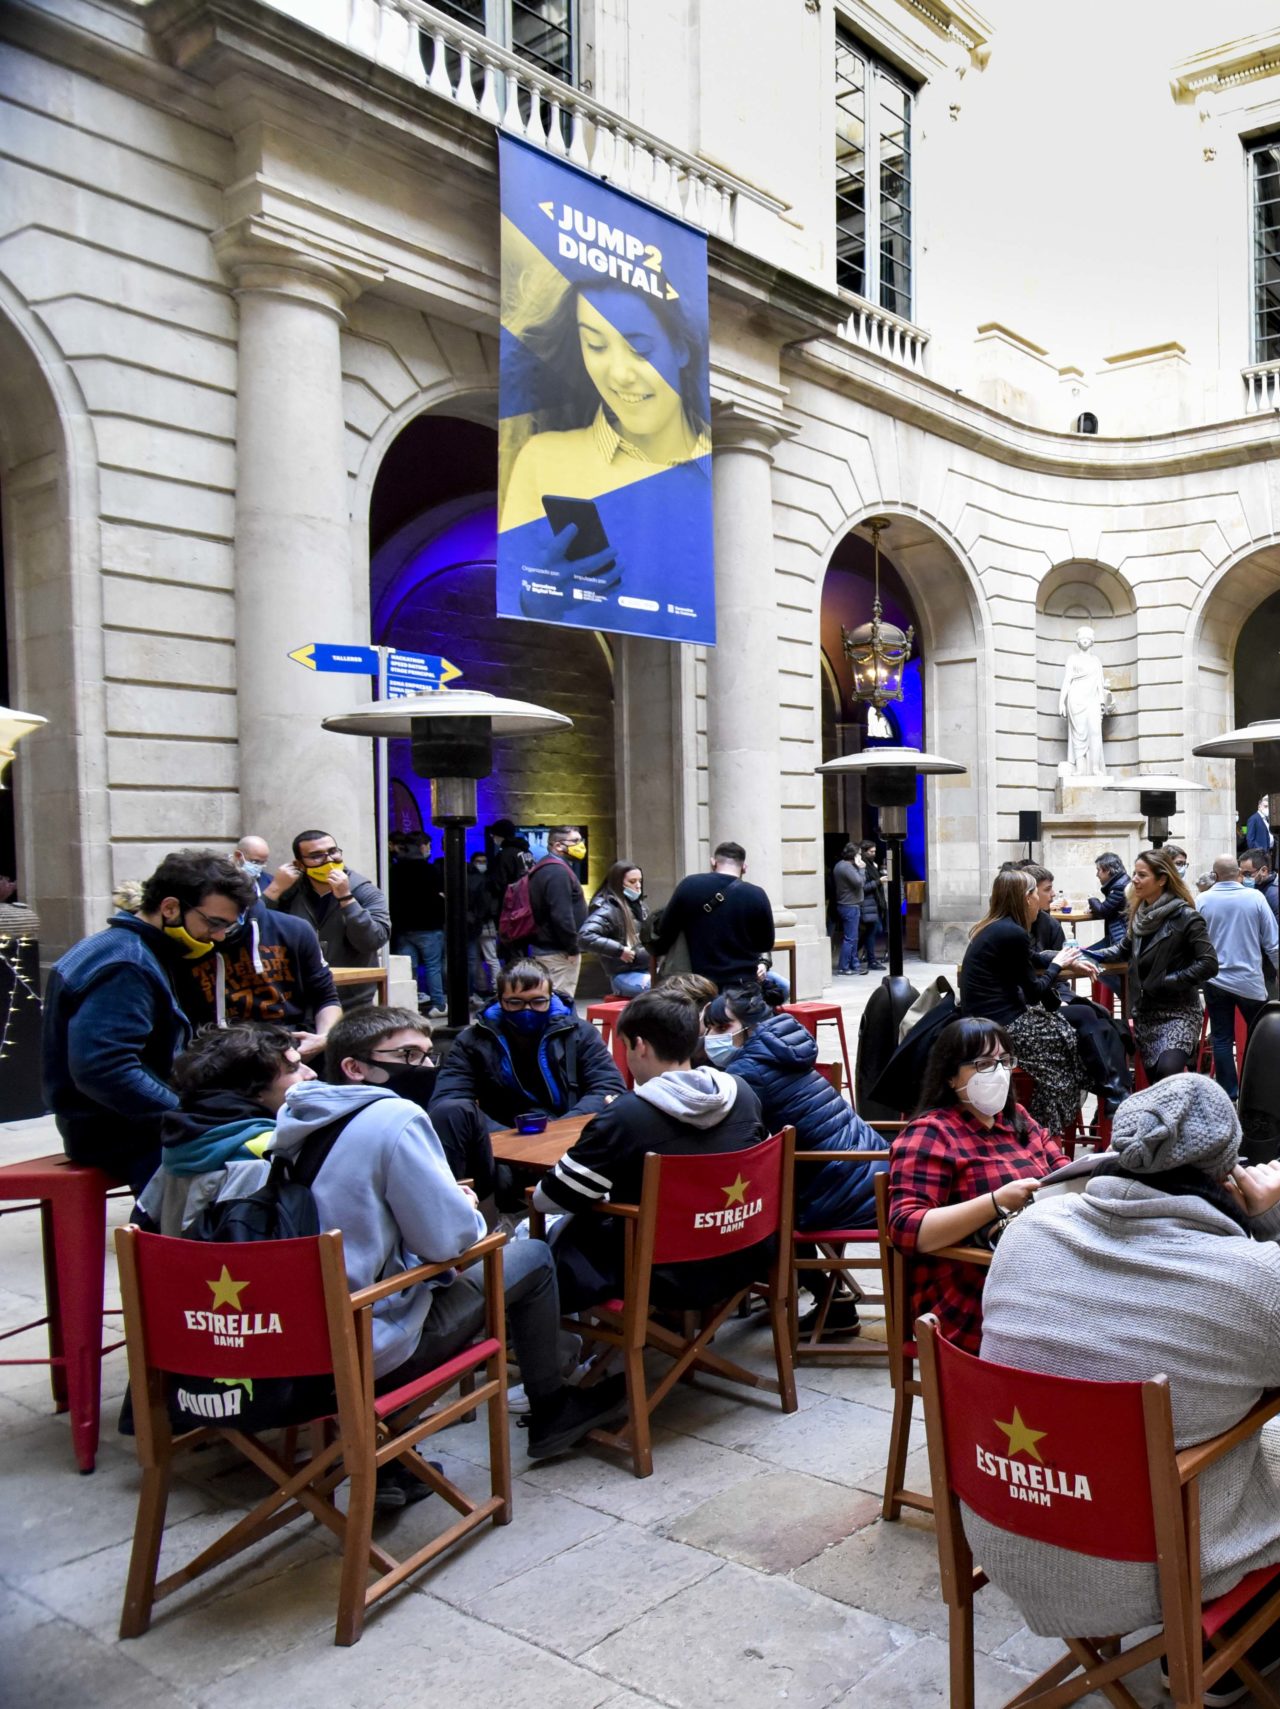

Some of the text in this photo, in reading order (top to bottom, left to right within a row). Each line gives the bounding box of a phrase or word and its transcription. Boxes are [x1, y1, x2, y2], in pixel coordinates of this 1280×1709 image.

[558, 204, 663, 273] JUMP2
[558, 231, 664, 299] DIGITAL
[694, 1198, 763, 1229] ESTRELLA
[720, 1220, 745, 1235] DAMM
[184, 1310, 283, 1336] ESTRELLA
[213, 1334, 245, 1348] DAMM
[177, 1387, 242, 1418] PUMA
[976, 1443, 1093, 1502] ESTRELLA
[1009, 1484, 1052, 1507] DAMM
